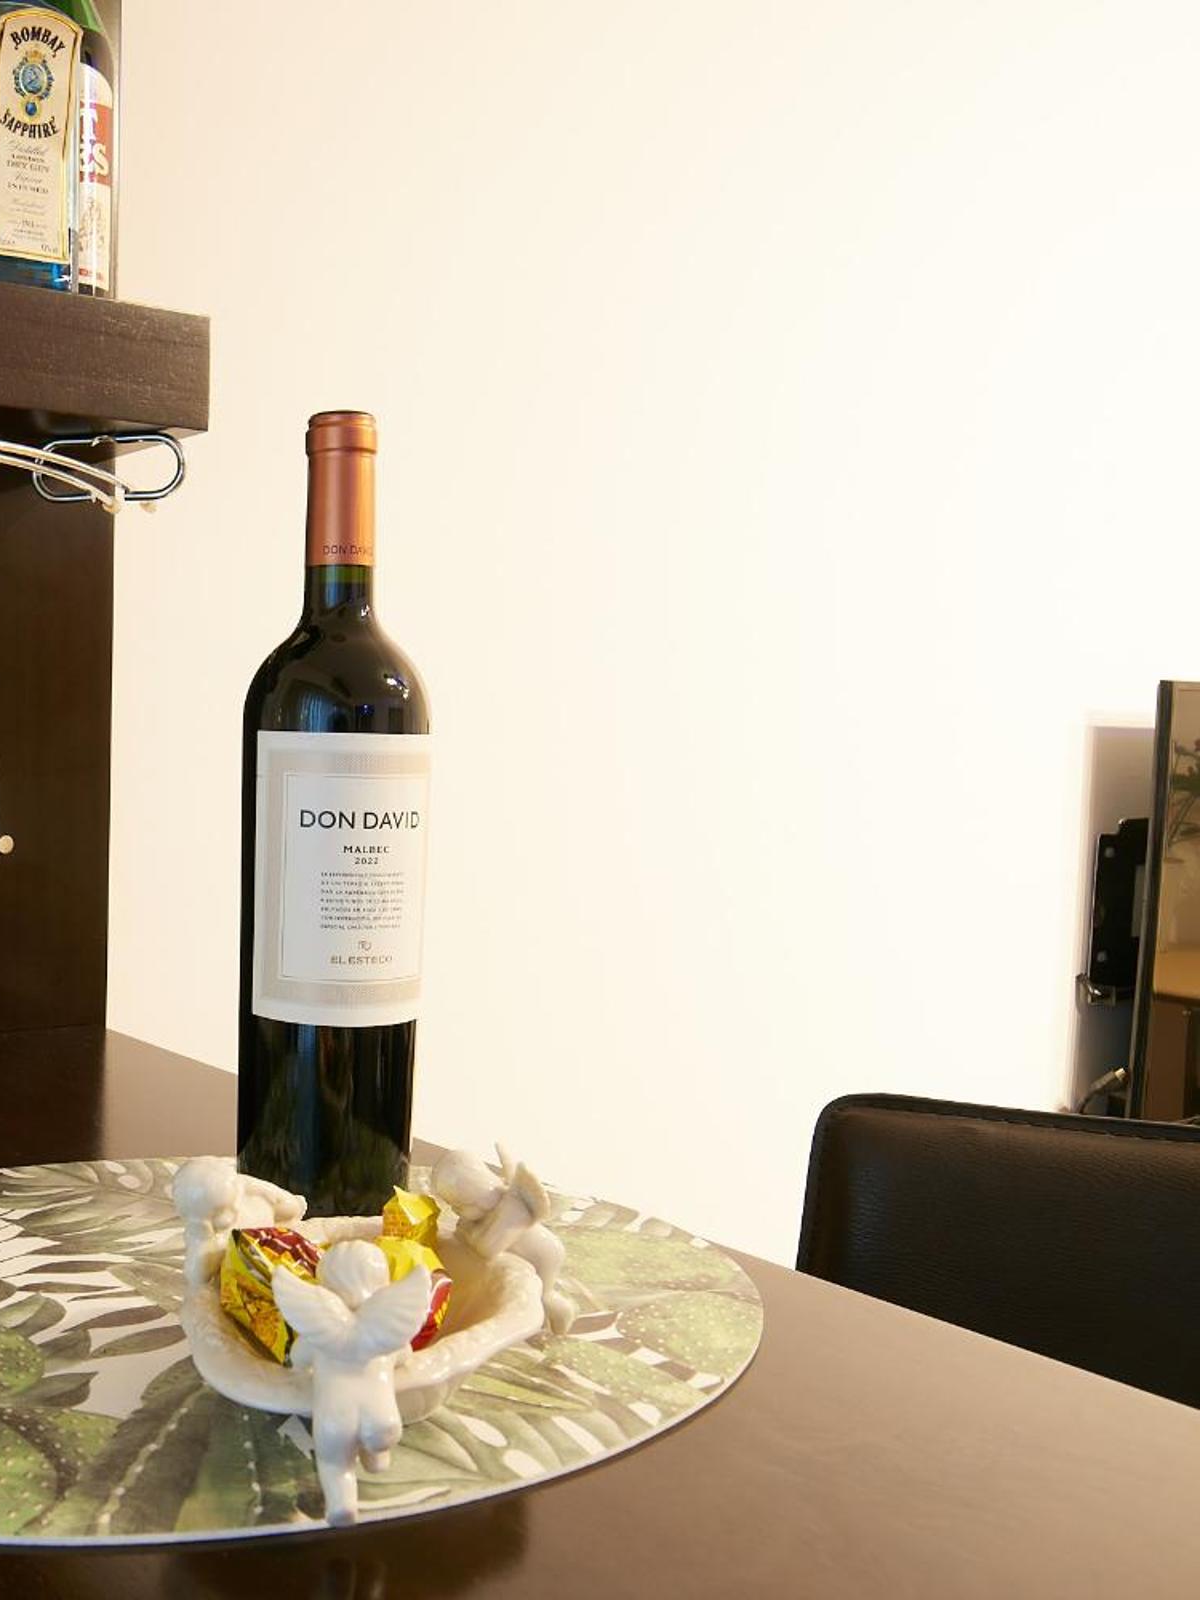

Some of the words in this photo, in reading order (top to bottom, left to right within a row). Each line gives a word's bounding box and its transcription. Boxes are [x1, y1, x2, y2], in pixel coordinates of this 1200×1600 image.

[10, 26, 66, 58] BOMBAY
[0, 108, 59, 139] SAPPHIRE
[323, 544, 347, 555] DON
[299, 809, 356, 829] DON
[363, 811, 421, 830] DAVID
[343, 845, 391, 854] MALBEC
[354, 856, 379, 865] 2022
